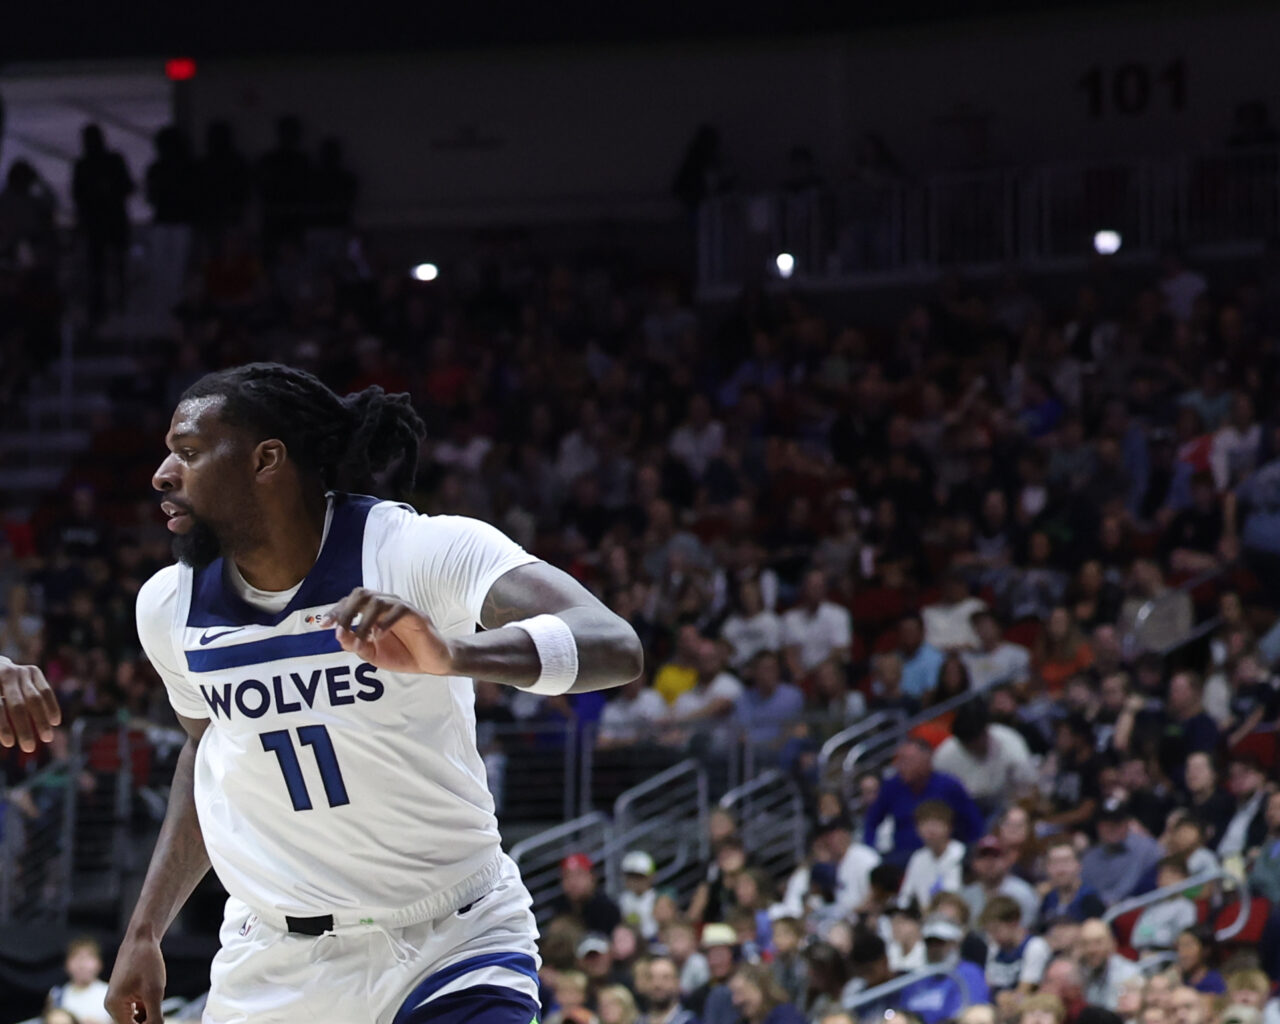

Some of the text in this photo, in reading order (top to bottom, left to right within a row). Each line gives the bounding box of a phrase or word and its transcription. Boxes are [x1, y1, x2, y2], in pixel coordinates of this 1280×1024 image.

[1077, 58, 1187, 117] 101
[200, 663, 384, 720] WOLVES
[258, 724, 350, 812] 11
